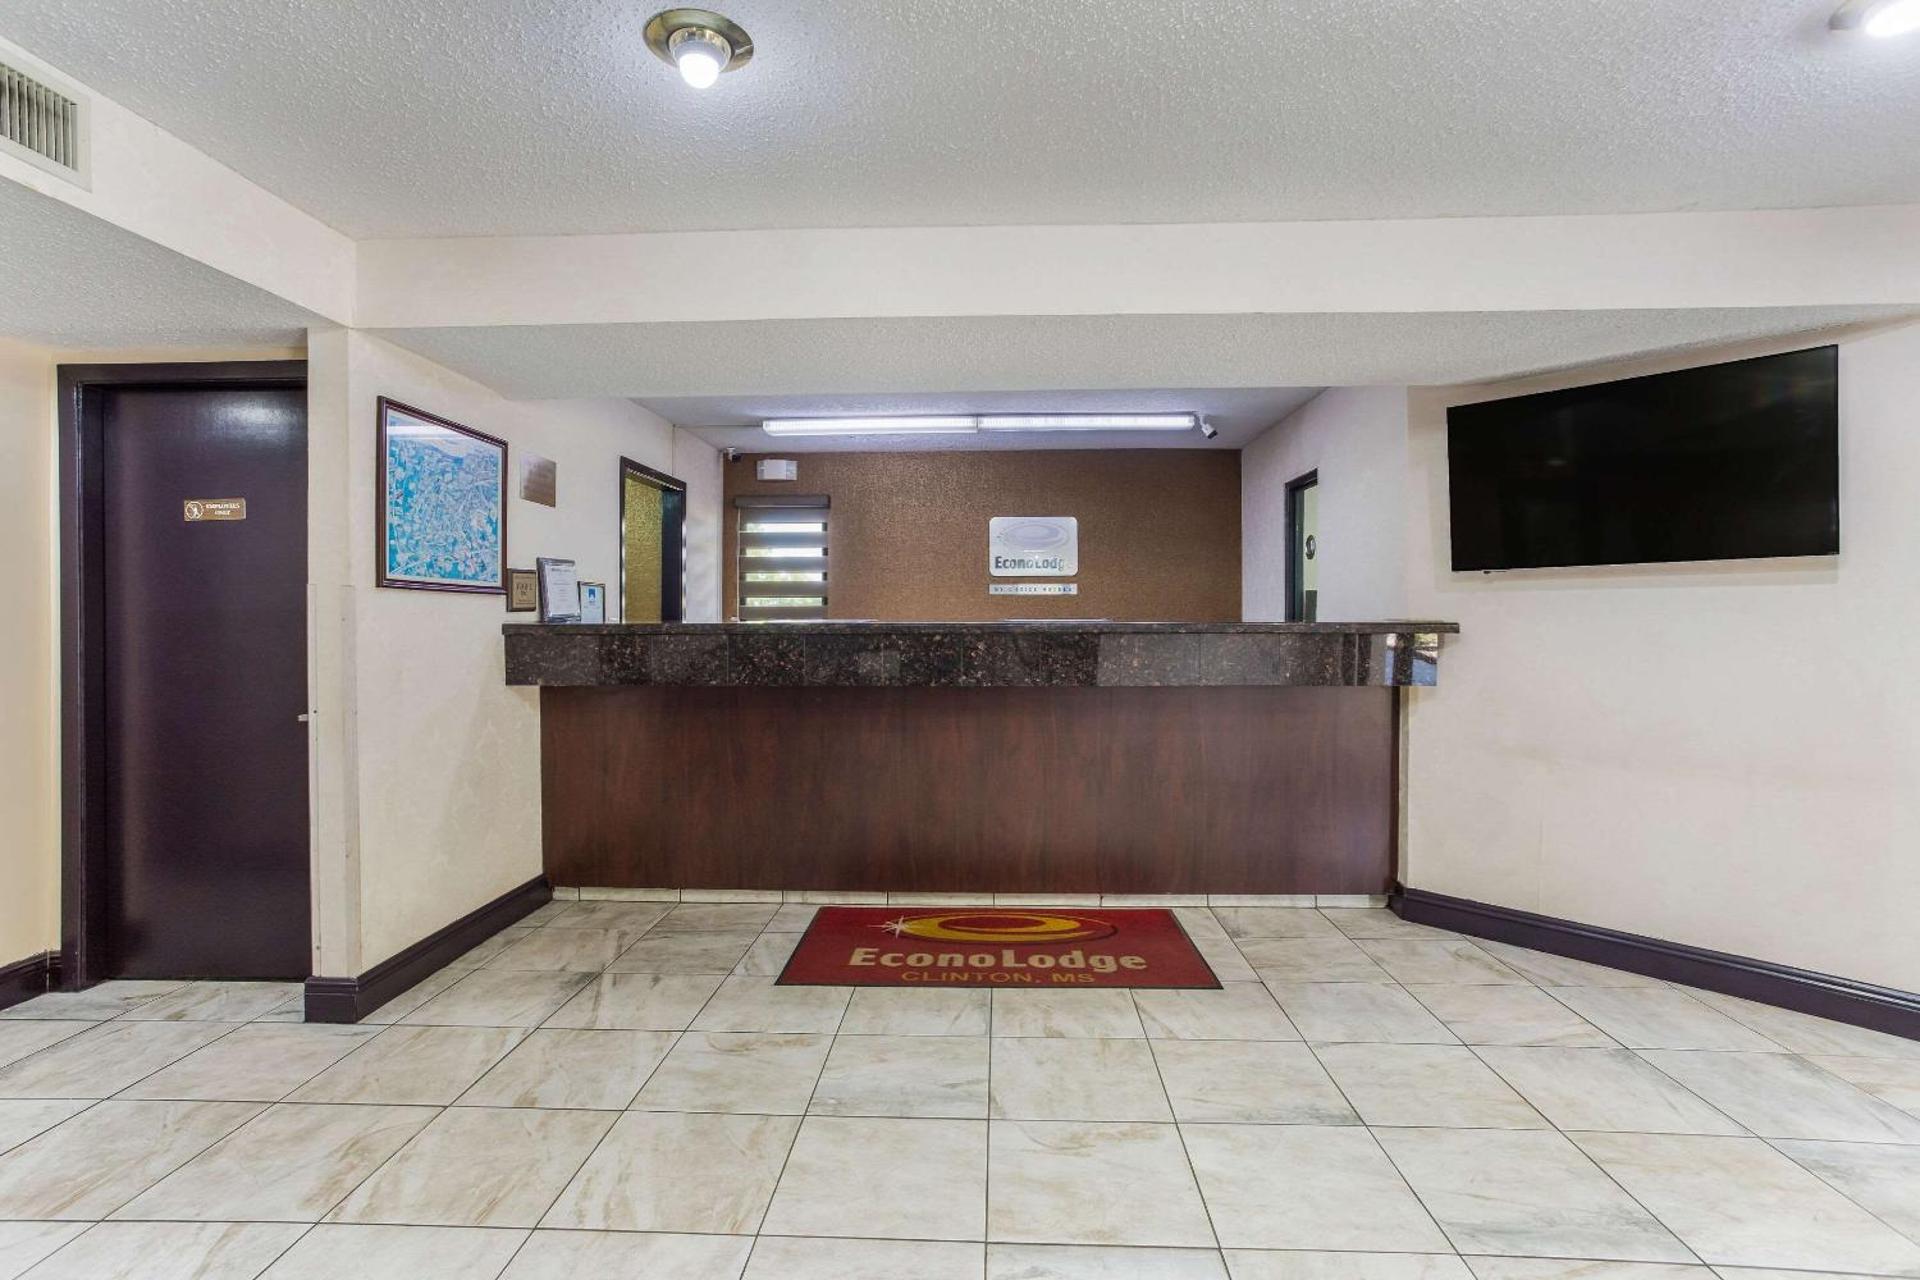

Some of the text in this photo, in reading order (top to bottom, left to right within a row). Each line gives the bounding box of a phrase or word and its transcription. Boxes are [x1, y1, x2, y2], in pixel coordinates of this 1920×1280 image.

[995, 556, 1072, 571] EconoLodg
[848, 947, 1148, 973] EconoLodge
[1052, 972, 1096, 984] MS
